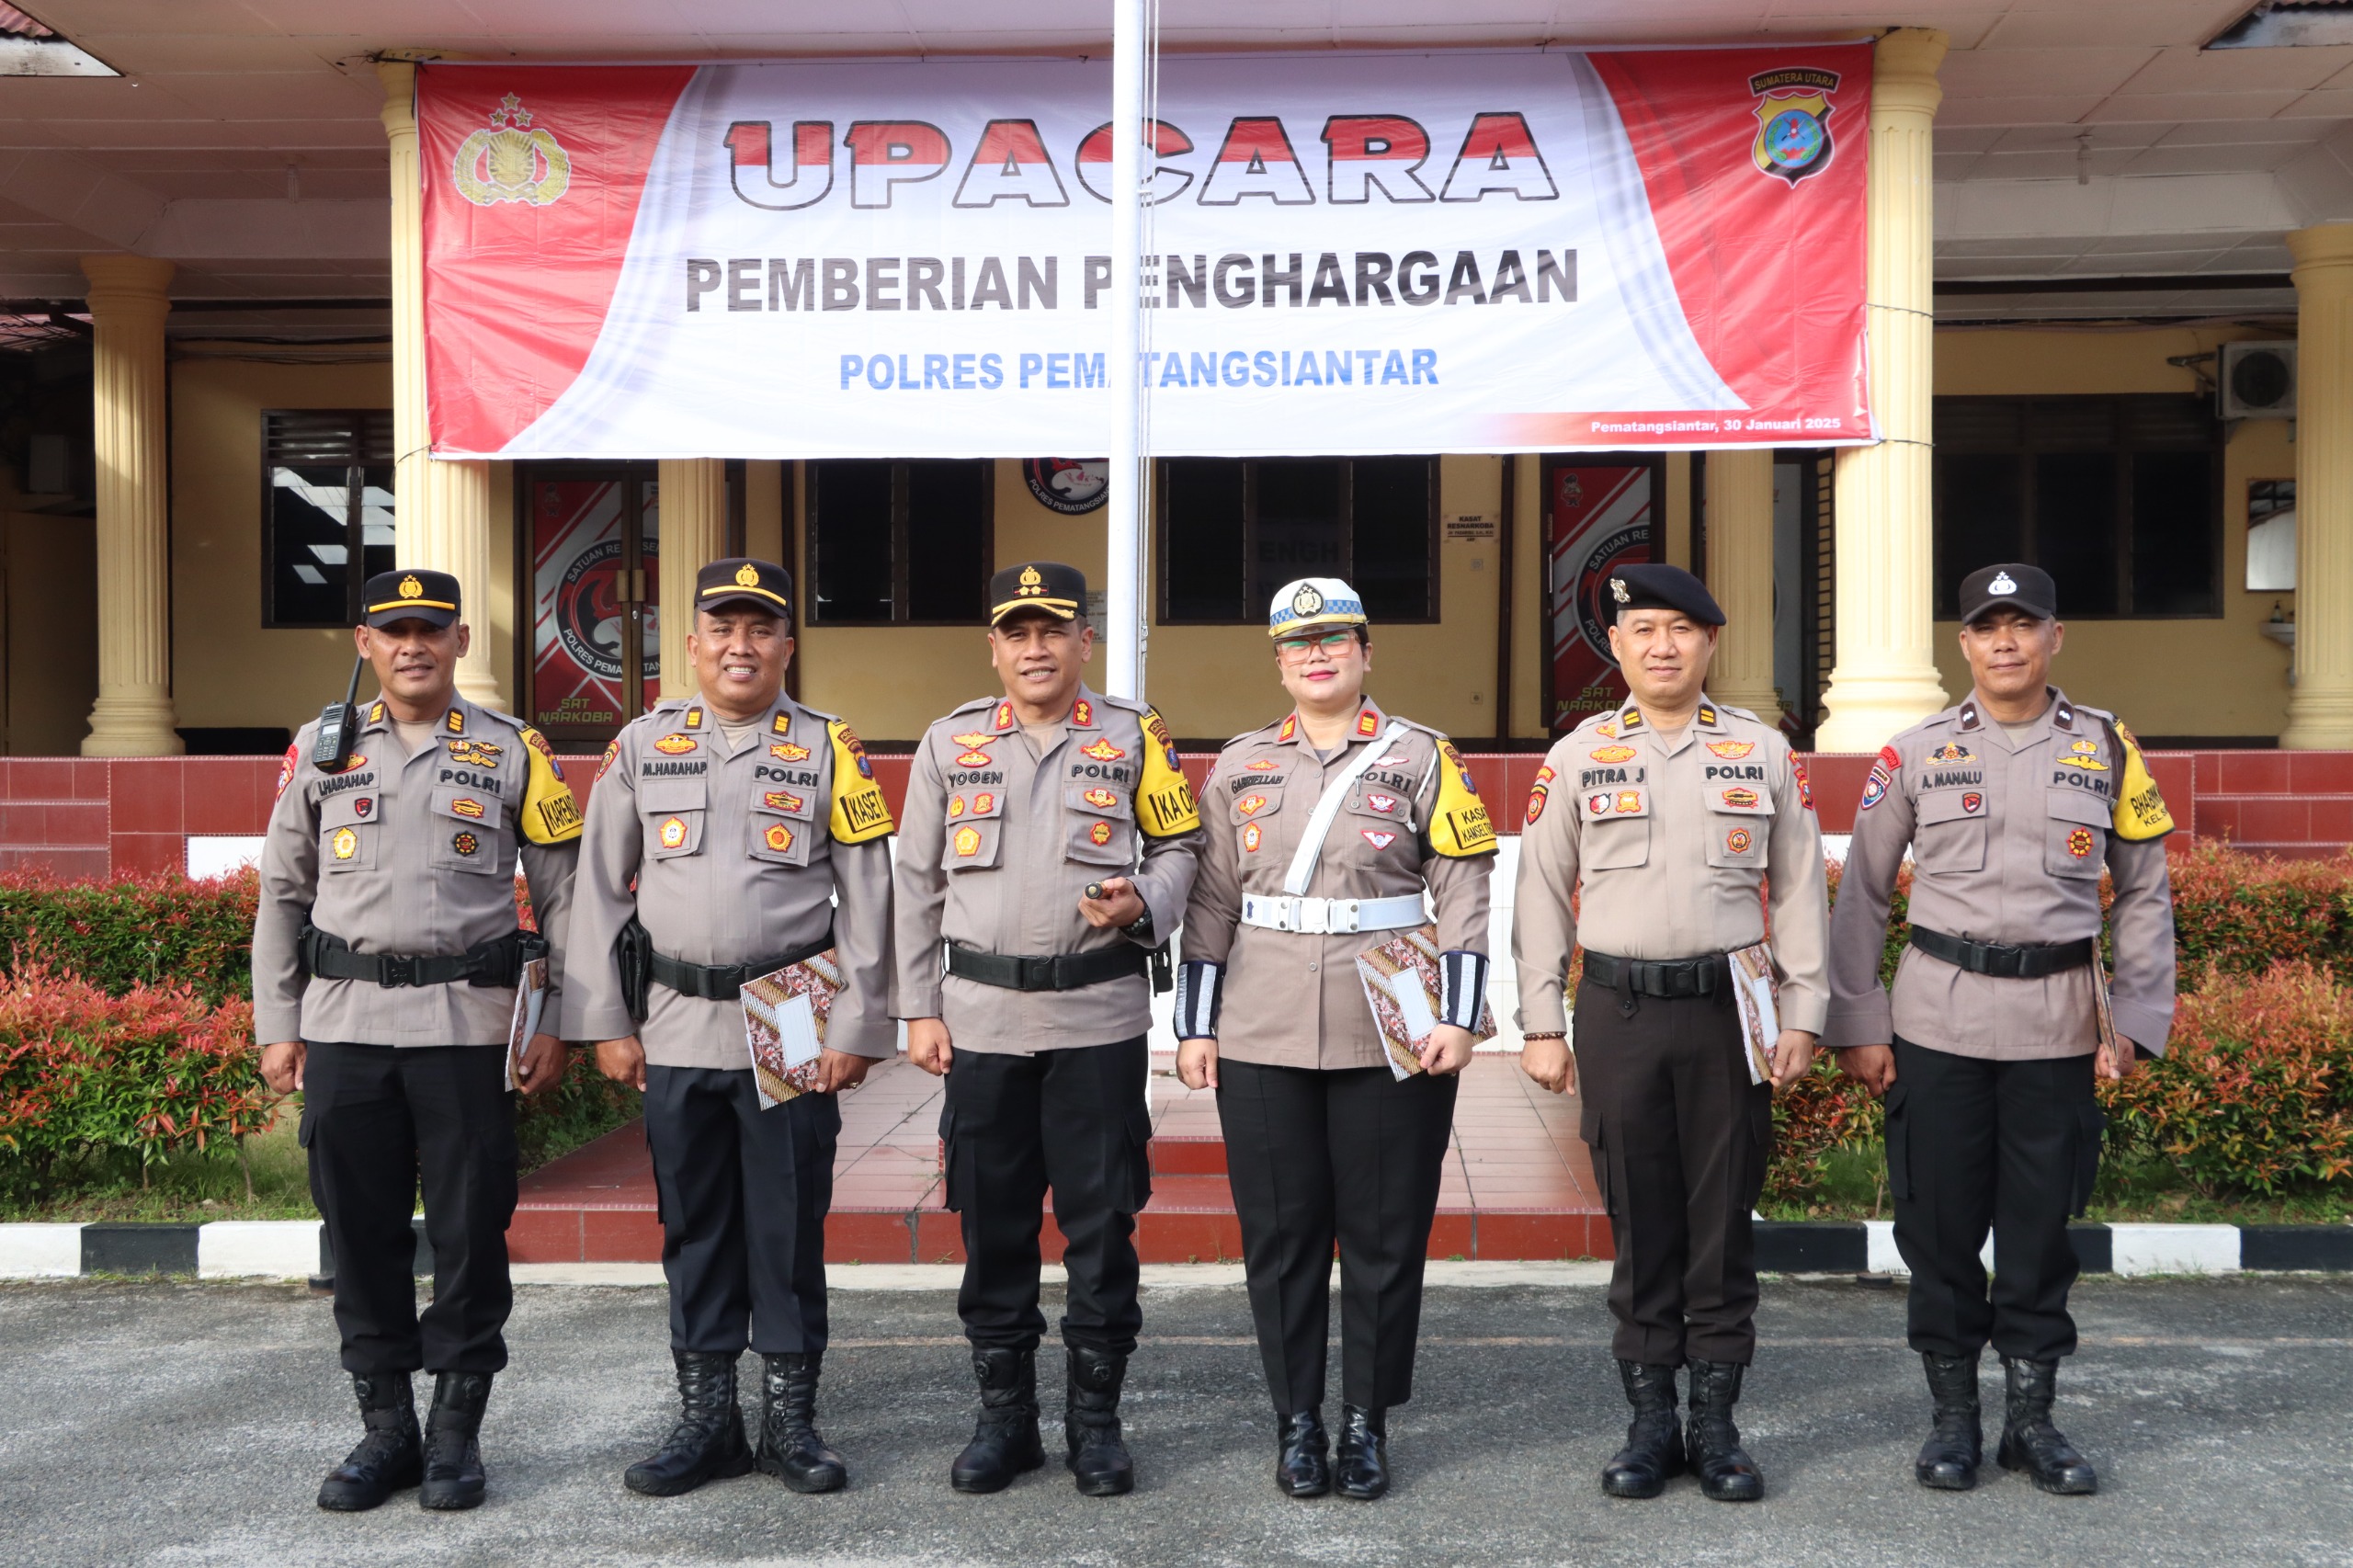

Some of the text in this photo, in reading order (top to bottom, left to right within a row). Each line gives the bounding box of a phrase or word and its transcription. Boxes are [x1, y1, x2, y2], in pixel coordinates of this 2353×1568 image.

[1755, 74, 1834, 90] SUMATERA UTARA
[723, 111, 1560, 210] UPACARA
[687, 248, 1579, 312] PEMBERIAN PENGHARGAAN
[840, 348, 1439, 391] POLRES PEMTANGSIANTAR
[1591, 417, 1841, 434] Pematangsiantar, 30 Januari 2025
[1029, 478, 1053, 506] POLRES
[1589, 533, 1630, 570] SATUAN
[567, 548, 604, 582] SATUAN
[563, 628, 594, 665] POLRES
[1585, 619, 1613, 655] POLRE
[561, 698, 590, 710] SAT
[1581, 687, 1614, 698] SAT
[538, 710, 613, 723] NARKOBA
[439, 768, 501, 794] POLRI
[642, 761, 707, 777] M.HARAHAP
[754, 765, 819, 788] POLRI
[948, 770, 1004, 789] YOGEN
[1071, 764, 1130, 783] POLRI
[1582, 767, 1644, 788] PITRA J
[1705, 766, 1764, 780] POLRI
[1922, 771, 1983, 790] A. MANALU
[2053, 771, 2109, 796] POLRI
[848, 790, 884, 826] KASET
[1158, 791, 1184, 824] KA
